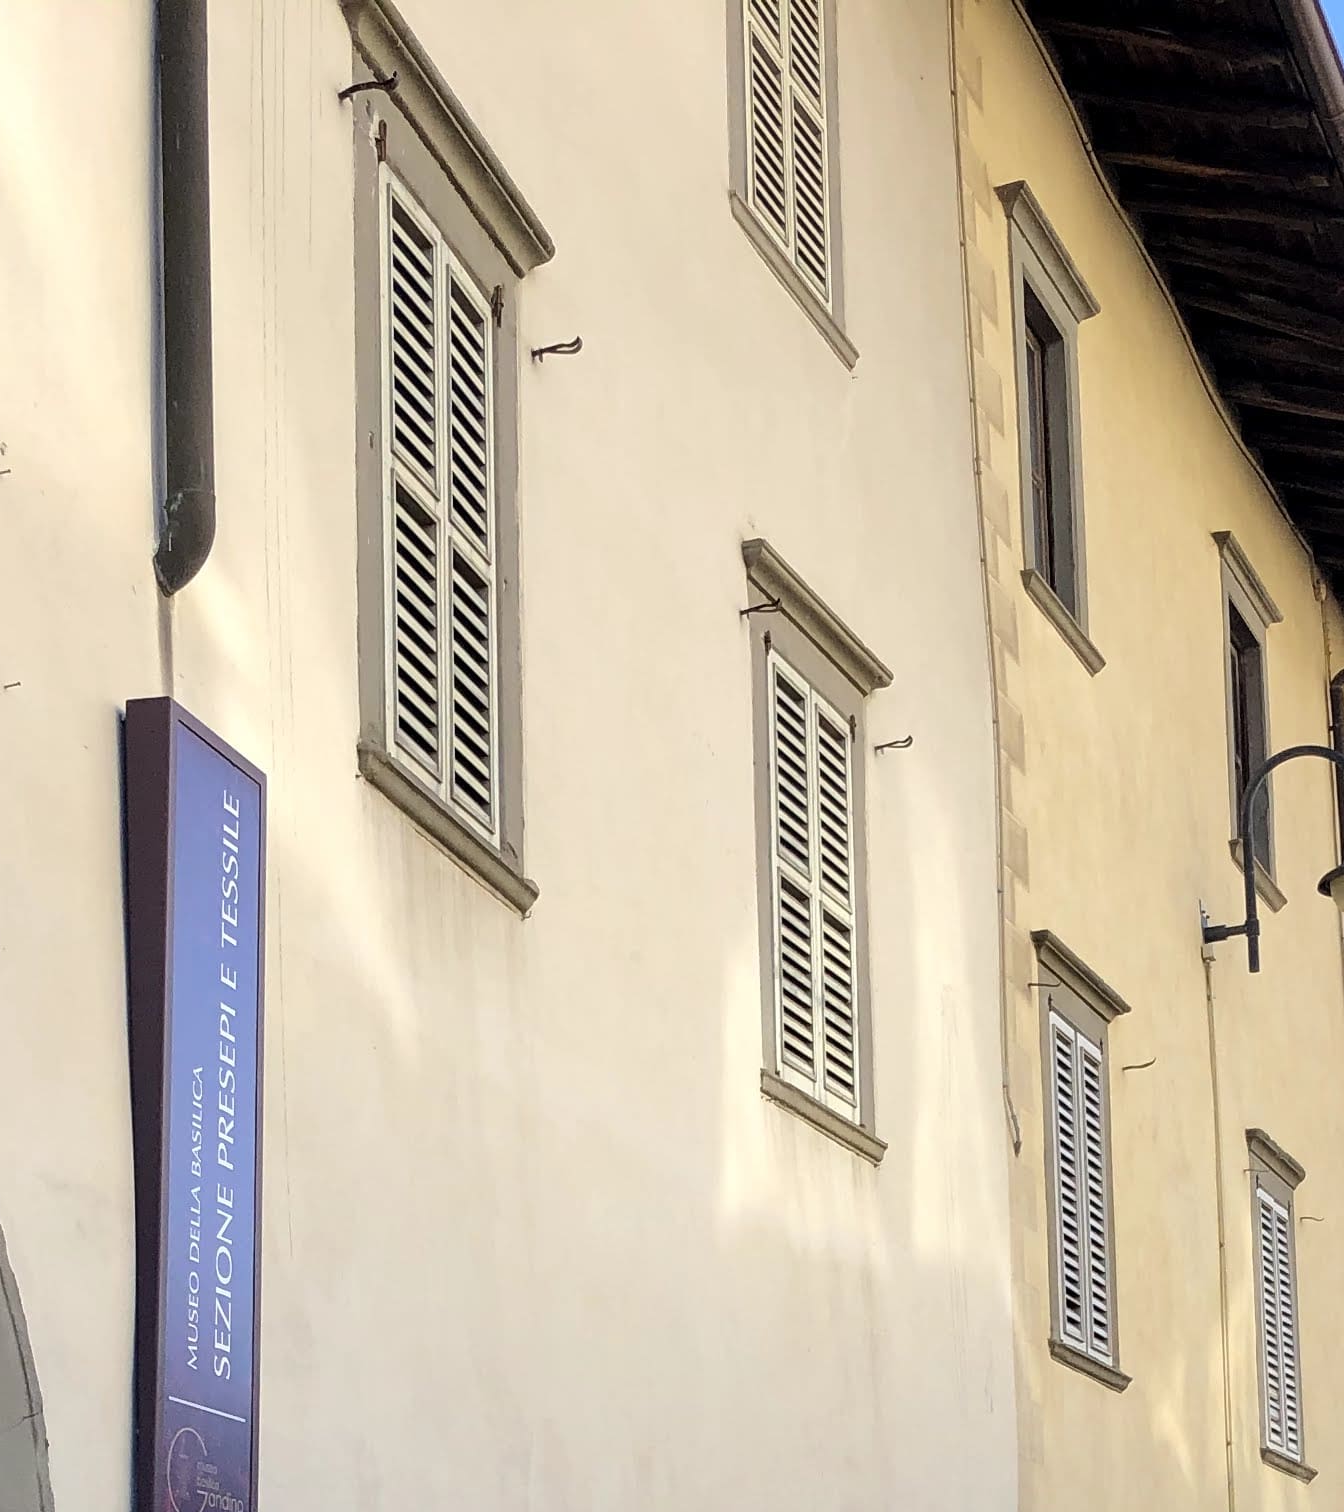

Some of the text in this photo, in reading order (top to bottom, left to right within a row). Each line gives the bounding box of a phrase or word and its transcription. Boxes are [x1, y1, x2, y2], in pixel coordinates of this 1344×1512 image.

[187, 1066, 203, 1370] MUSEO DELLA BASILICA
[214, 789, 240, 1380] SEZIONE PRESEPI E TESSILE
